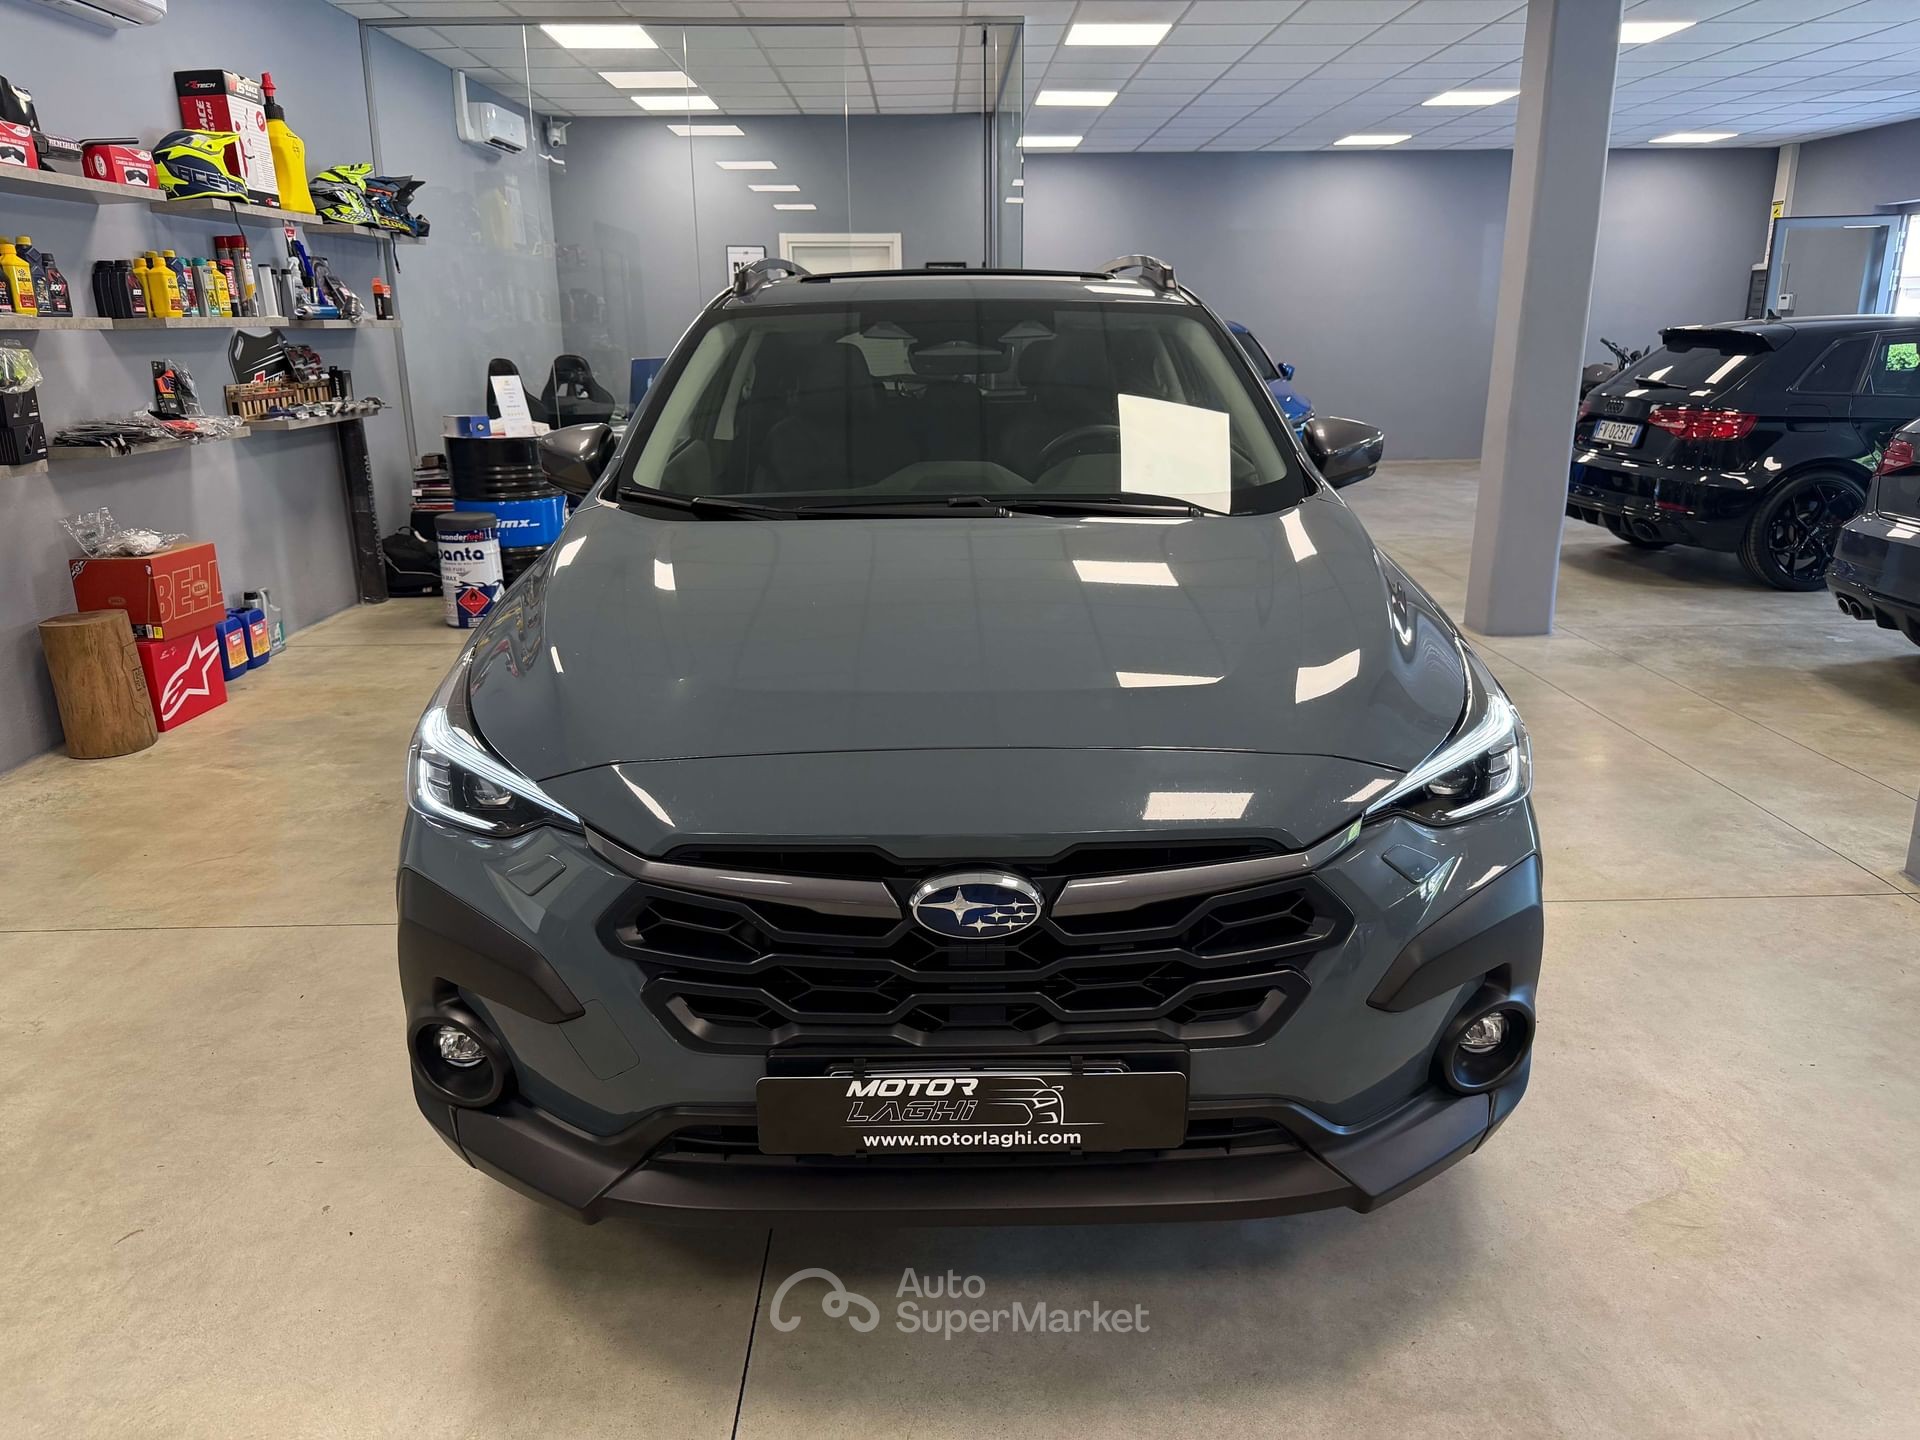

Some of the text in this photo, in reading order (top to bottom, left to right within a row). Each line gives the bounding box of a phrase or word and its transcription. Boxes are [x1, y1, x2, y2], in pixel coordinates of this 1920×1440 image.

[195, 99, 209, 132] ACE
[227, 270, 237, 296] MOTUL
[148, 560, 225, 625] BELL
[846, 1078, 979, 1098] MOTOR
[863, 1130, 1082, 1148] www.motorlaghi.com
